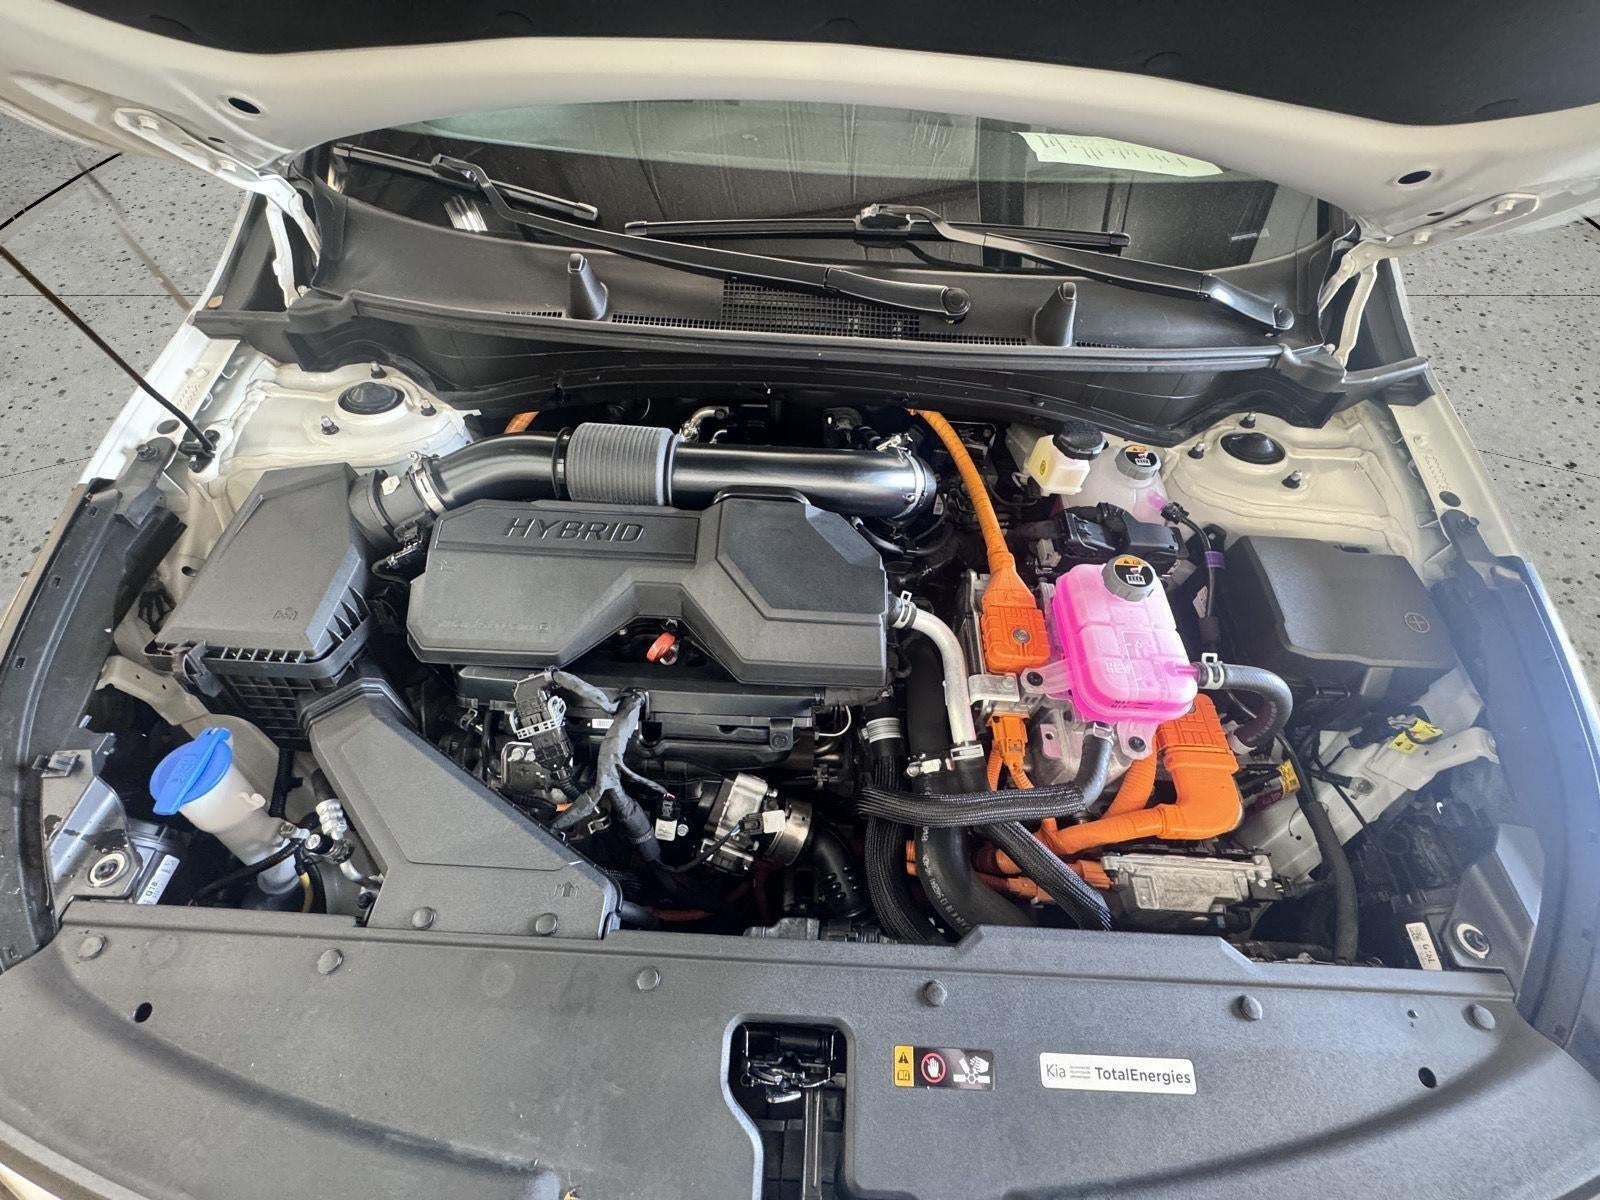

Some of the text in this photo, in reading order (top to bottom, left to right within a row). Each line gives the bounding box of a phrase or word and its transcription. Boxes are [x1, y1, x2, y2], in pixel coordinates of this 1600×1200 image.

[504, 517, 645, 543] HYBRID
[1046, 1064, 1066, 1078] Kia
[1094, 1067, 1191, 1086] TotalEnergies
